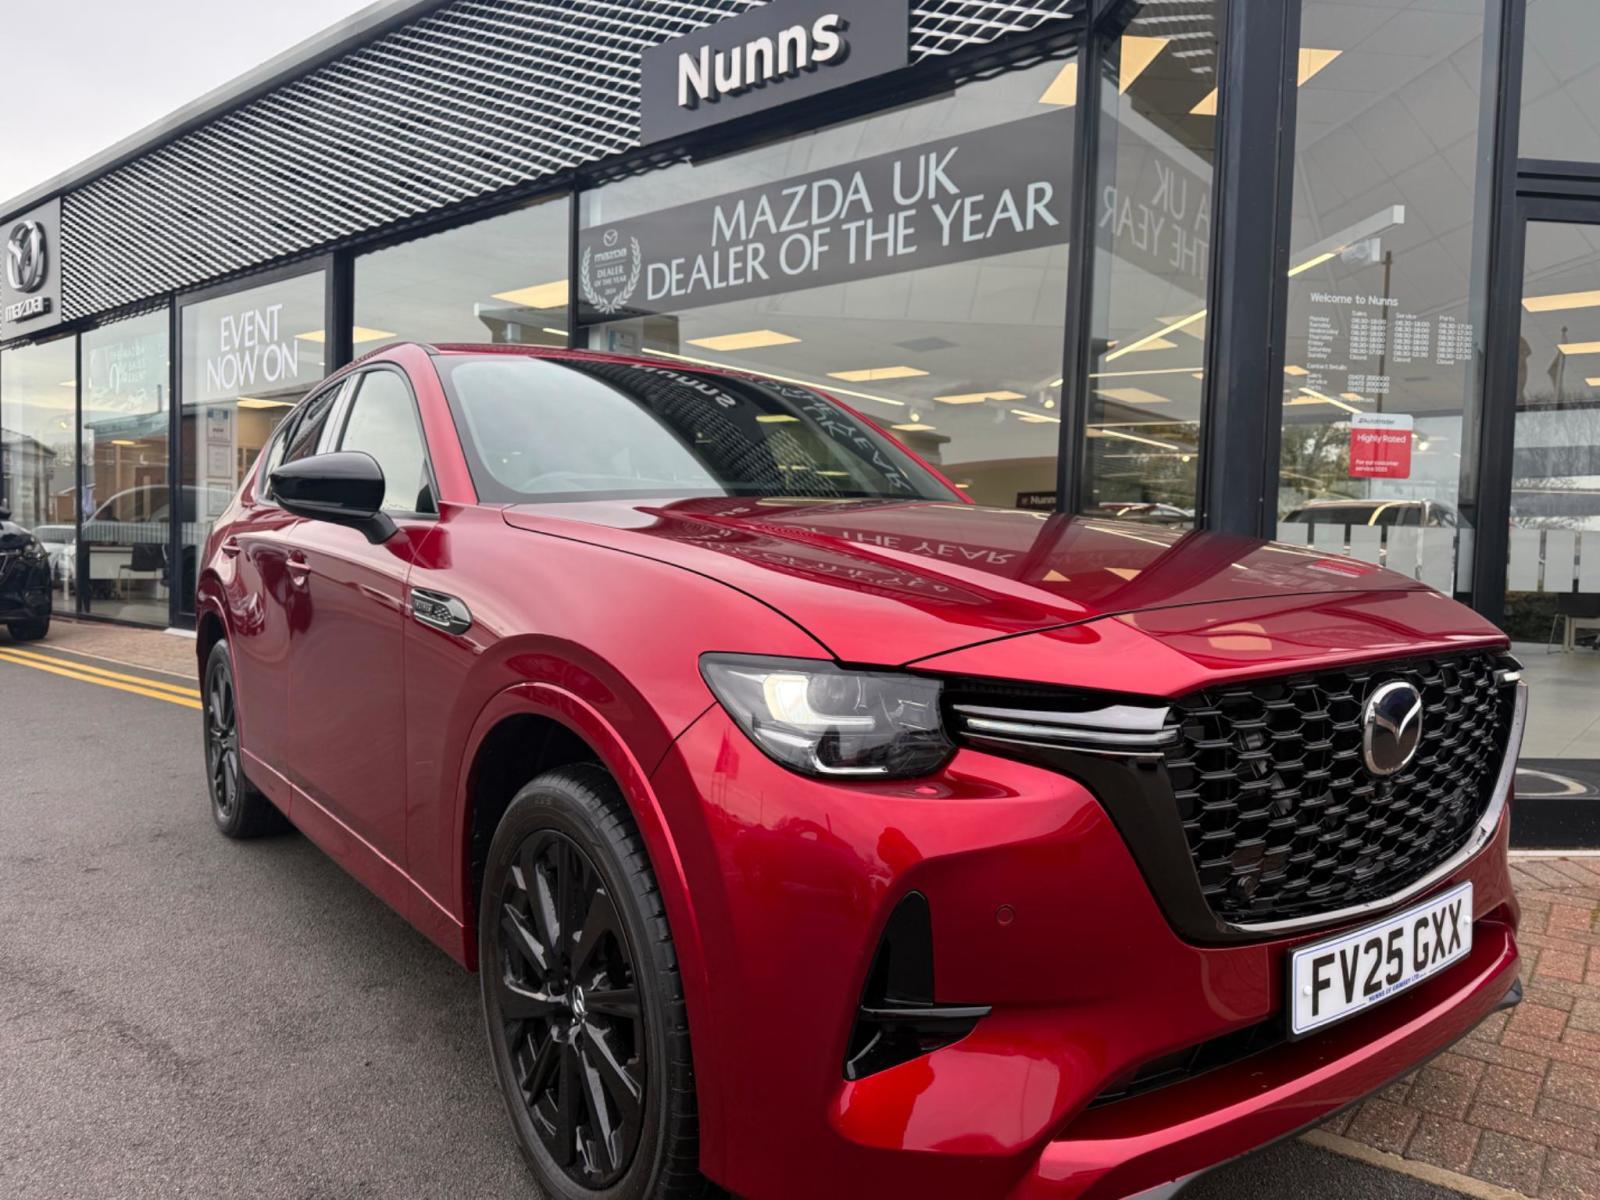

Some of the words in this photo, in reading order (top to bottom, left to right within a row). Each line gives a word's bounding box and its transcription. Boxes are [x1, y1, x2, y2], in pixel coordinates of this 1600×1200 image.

[678, 14, 843, 107] Nunns
[711, 171, 873, 247] MAZDA
[893, 146, 960, 205] UK
[647, 243, 770, 301] DEALER
[779, 227, 831, 275] OF
[842, 209, 917, 264] THE
[932, 181, 1060, 246] YEAR
[597, 265, 624, 278] DEALER
[5, 296, 50, 322] mazda
[1310, 292, 1352, 304] Welcome
[1355, 295, 1367, 305] to
[1368, 296, 1399, 307] Nunns
[221, 304, 283, 352] EVENT
[207, 345, 258, 393] NOW
[263, 340, 298, 382] ON
[1357, 433, 1381, 444] Highly
[1382, 434, 1406, 444] Rated
[1030, 496, 1056, 505] Nunn
[1312, 927, 1403, 1016] FV25
[1413, 899, 1462, 972] GXX
[1369, 989, 1385, 1002] NUNNS
